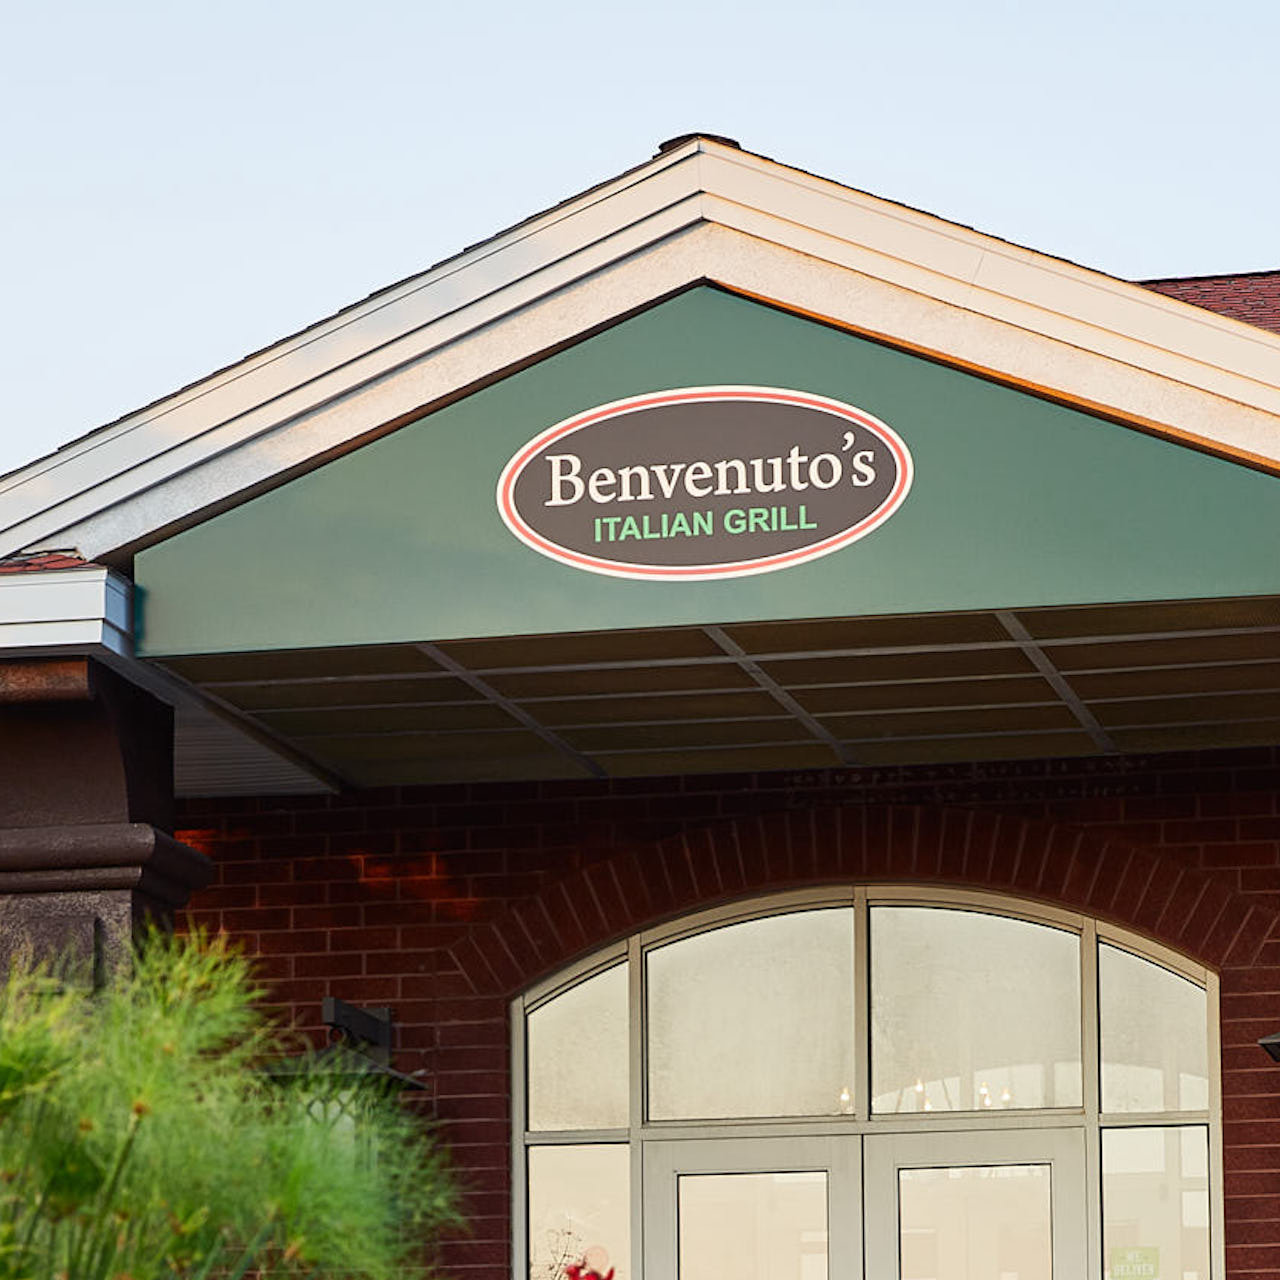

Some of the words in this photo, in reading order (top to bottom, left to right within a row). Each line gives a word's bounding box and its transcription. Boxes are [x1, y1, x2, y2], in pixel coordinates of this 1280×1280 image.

[544, 431, 876, 507] Benvenuto's
[594, 510, 713, 542] ITALIAN
[723, 505, 818, 534] GRILL
